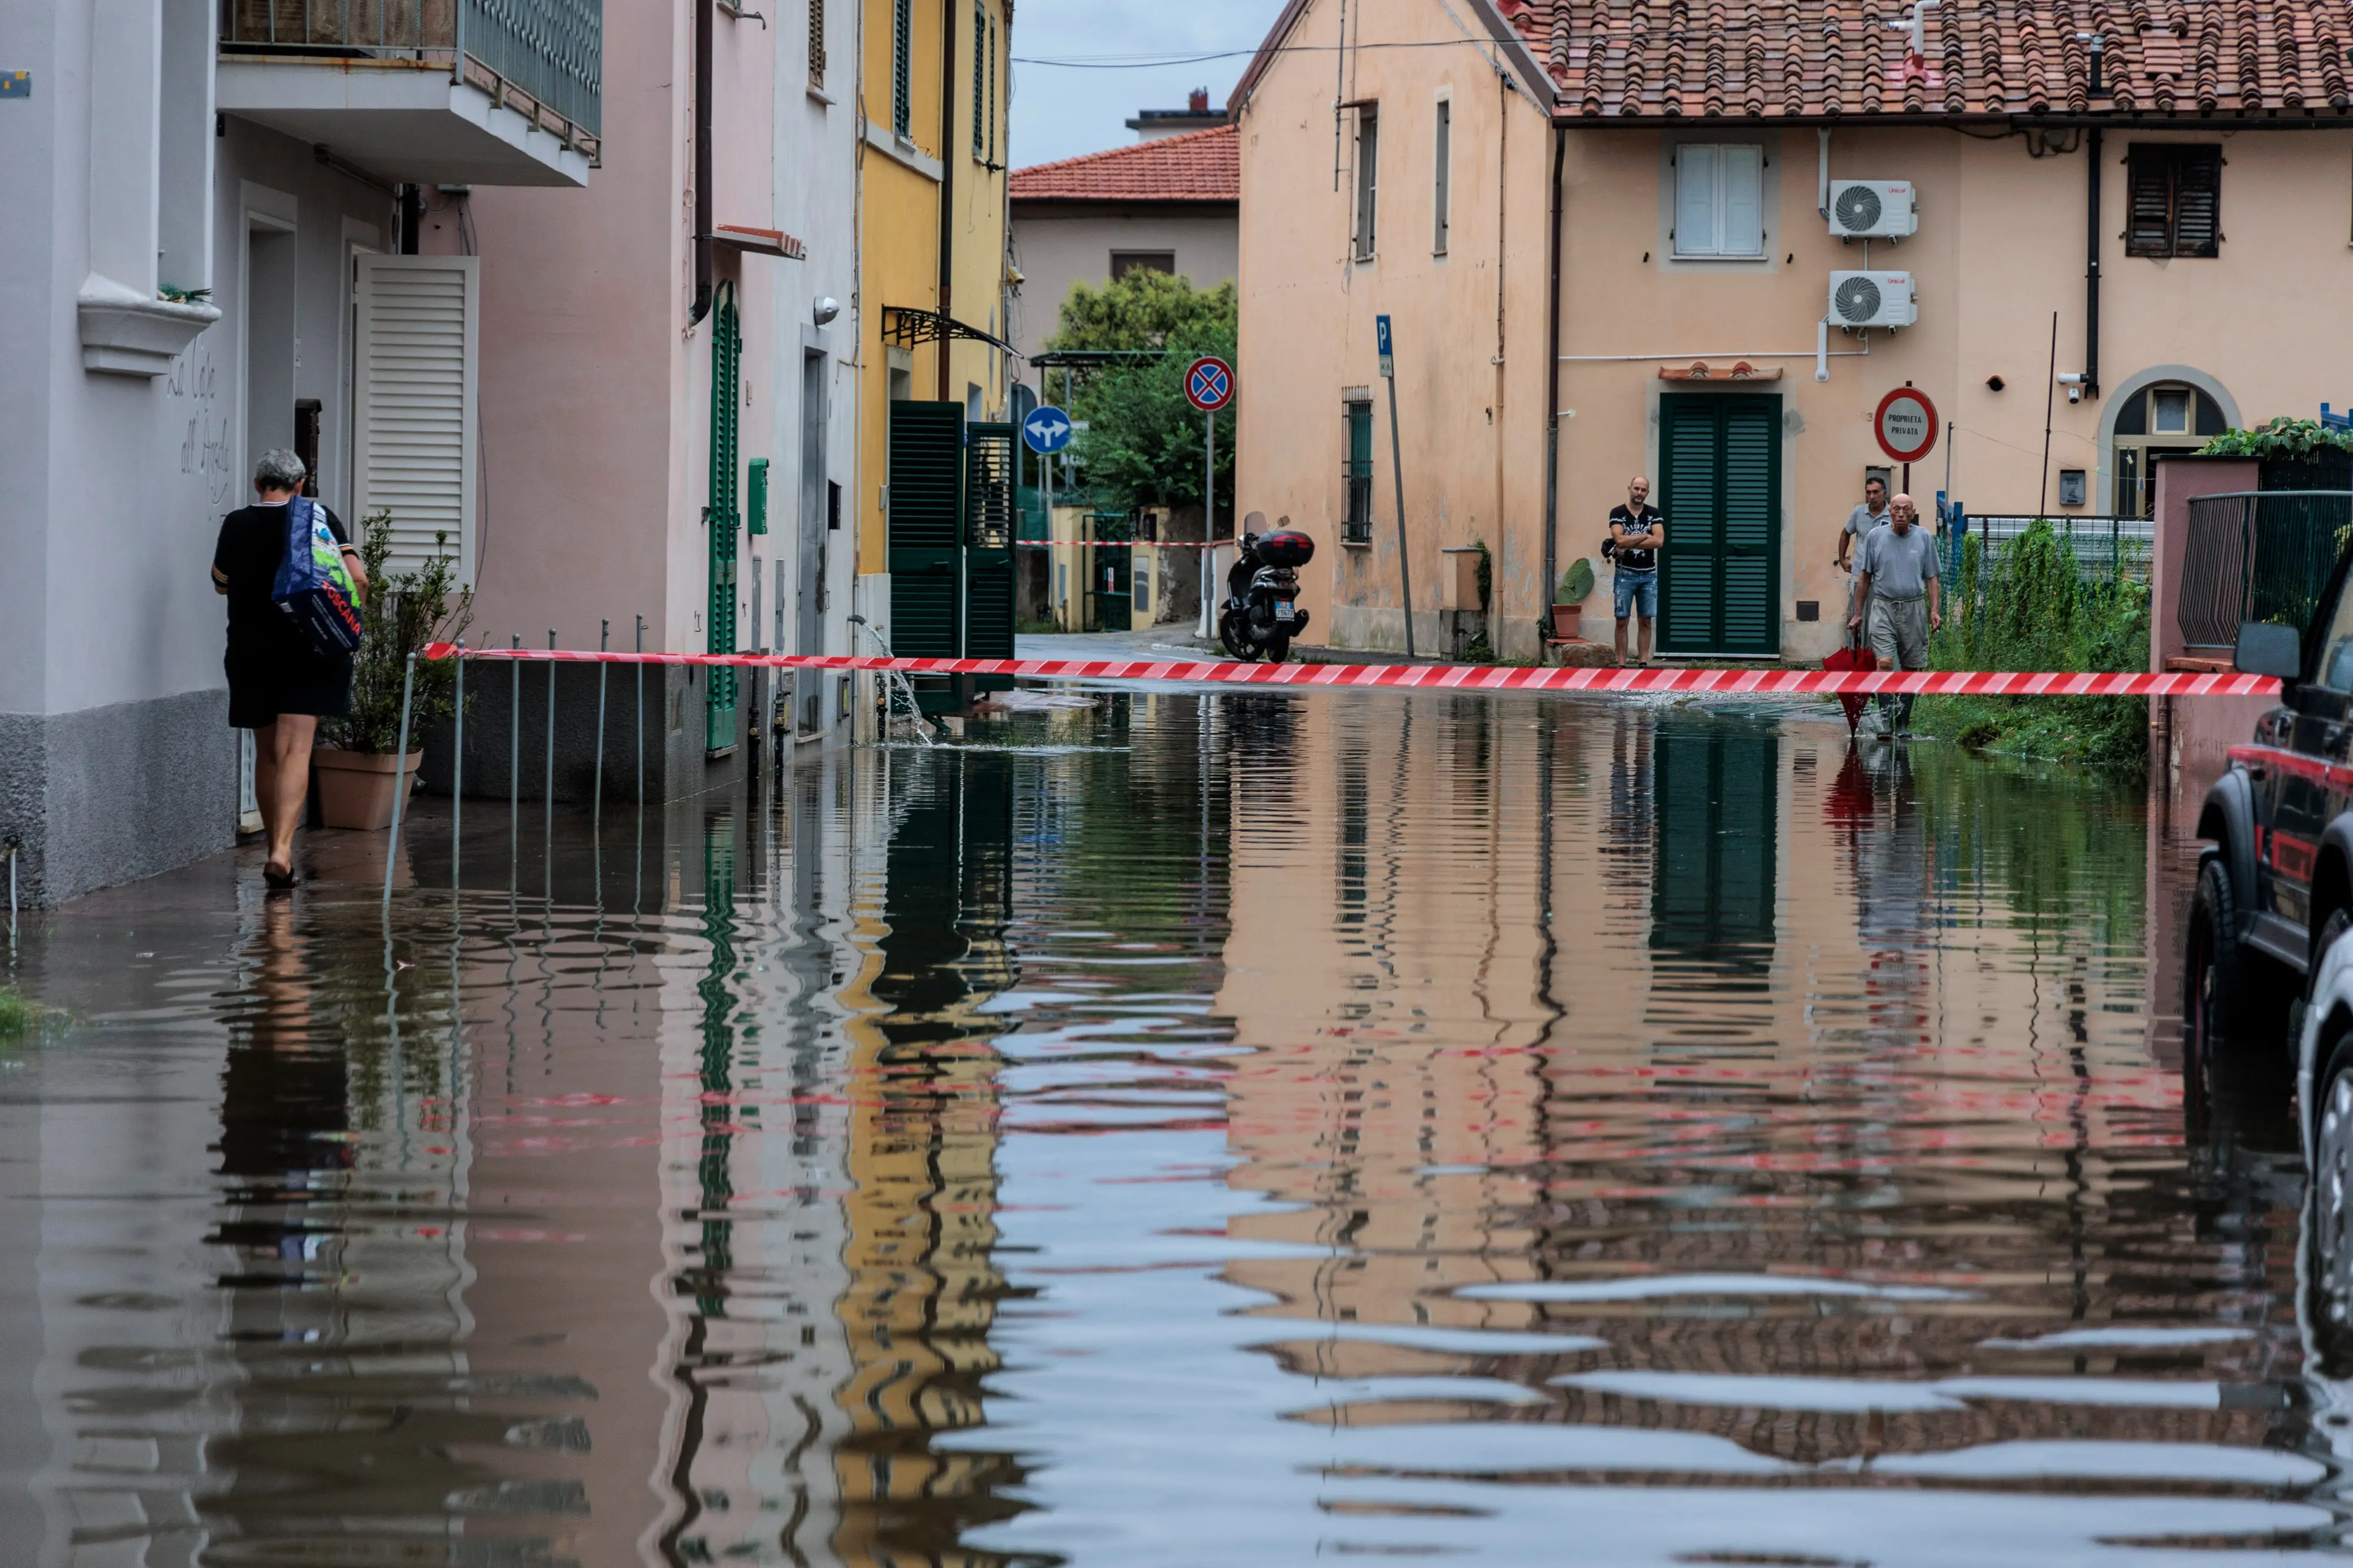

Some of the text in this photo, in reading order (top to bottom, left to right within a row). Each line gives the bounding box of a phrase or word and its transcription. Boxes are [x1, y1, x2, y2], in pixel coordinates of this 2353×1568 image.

[1379, 322, 1387, 349] P
[1888, 414, 1922, 423] PROPRIETA
[1891, 426, 1918, 435] PRIVATA
[321, 579, 362, 636] TOSCANA
